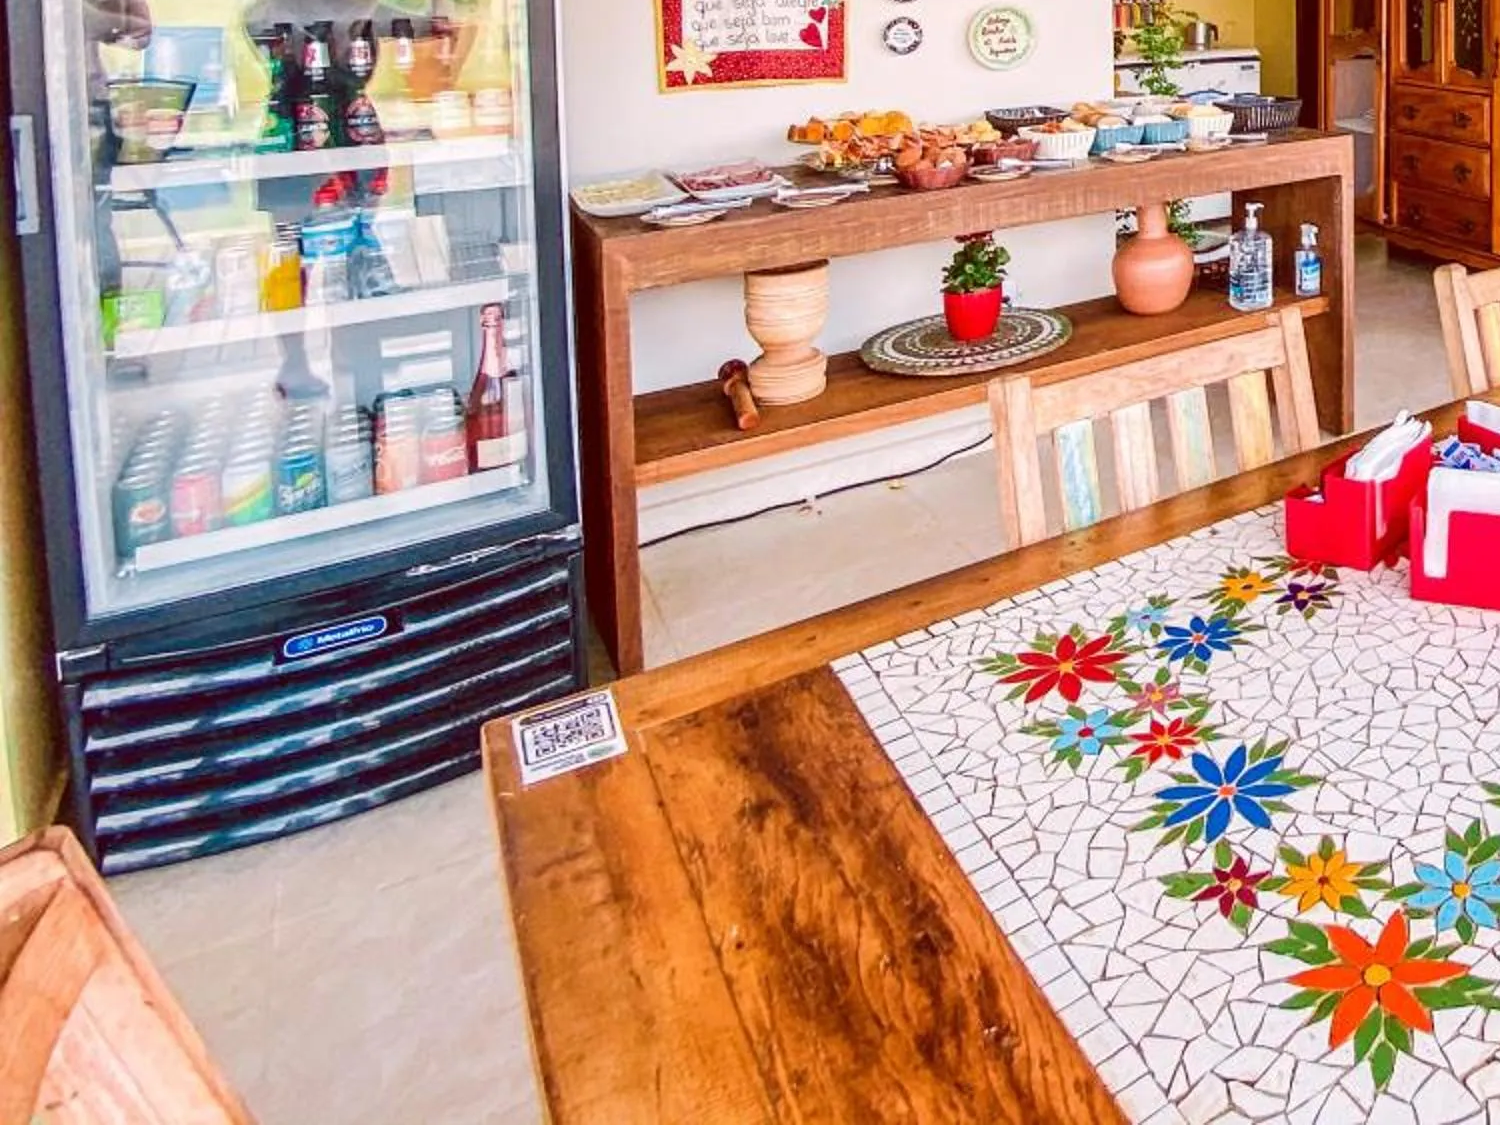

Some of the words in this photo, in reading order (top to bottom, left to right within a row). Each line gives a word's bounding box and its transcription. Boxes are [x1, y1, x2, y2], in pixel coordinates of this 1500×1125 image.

[694, 0, 723, 18] que
[691, 18, 717, 35] que
[723, 13, 756, 32] seja
[693, 35, 720, 52] que
[726, 31, 760, 50] seja
